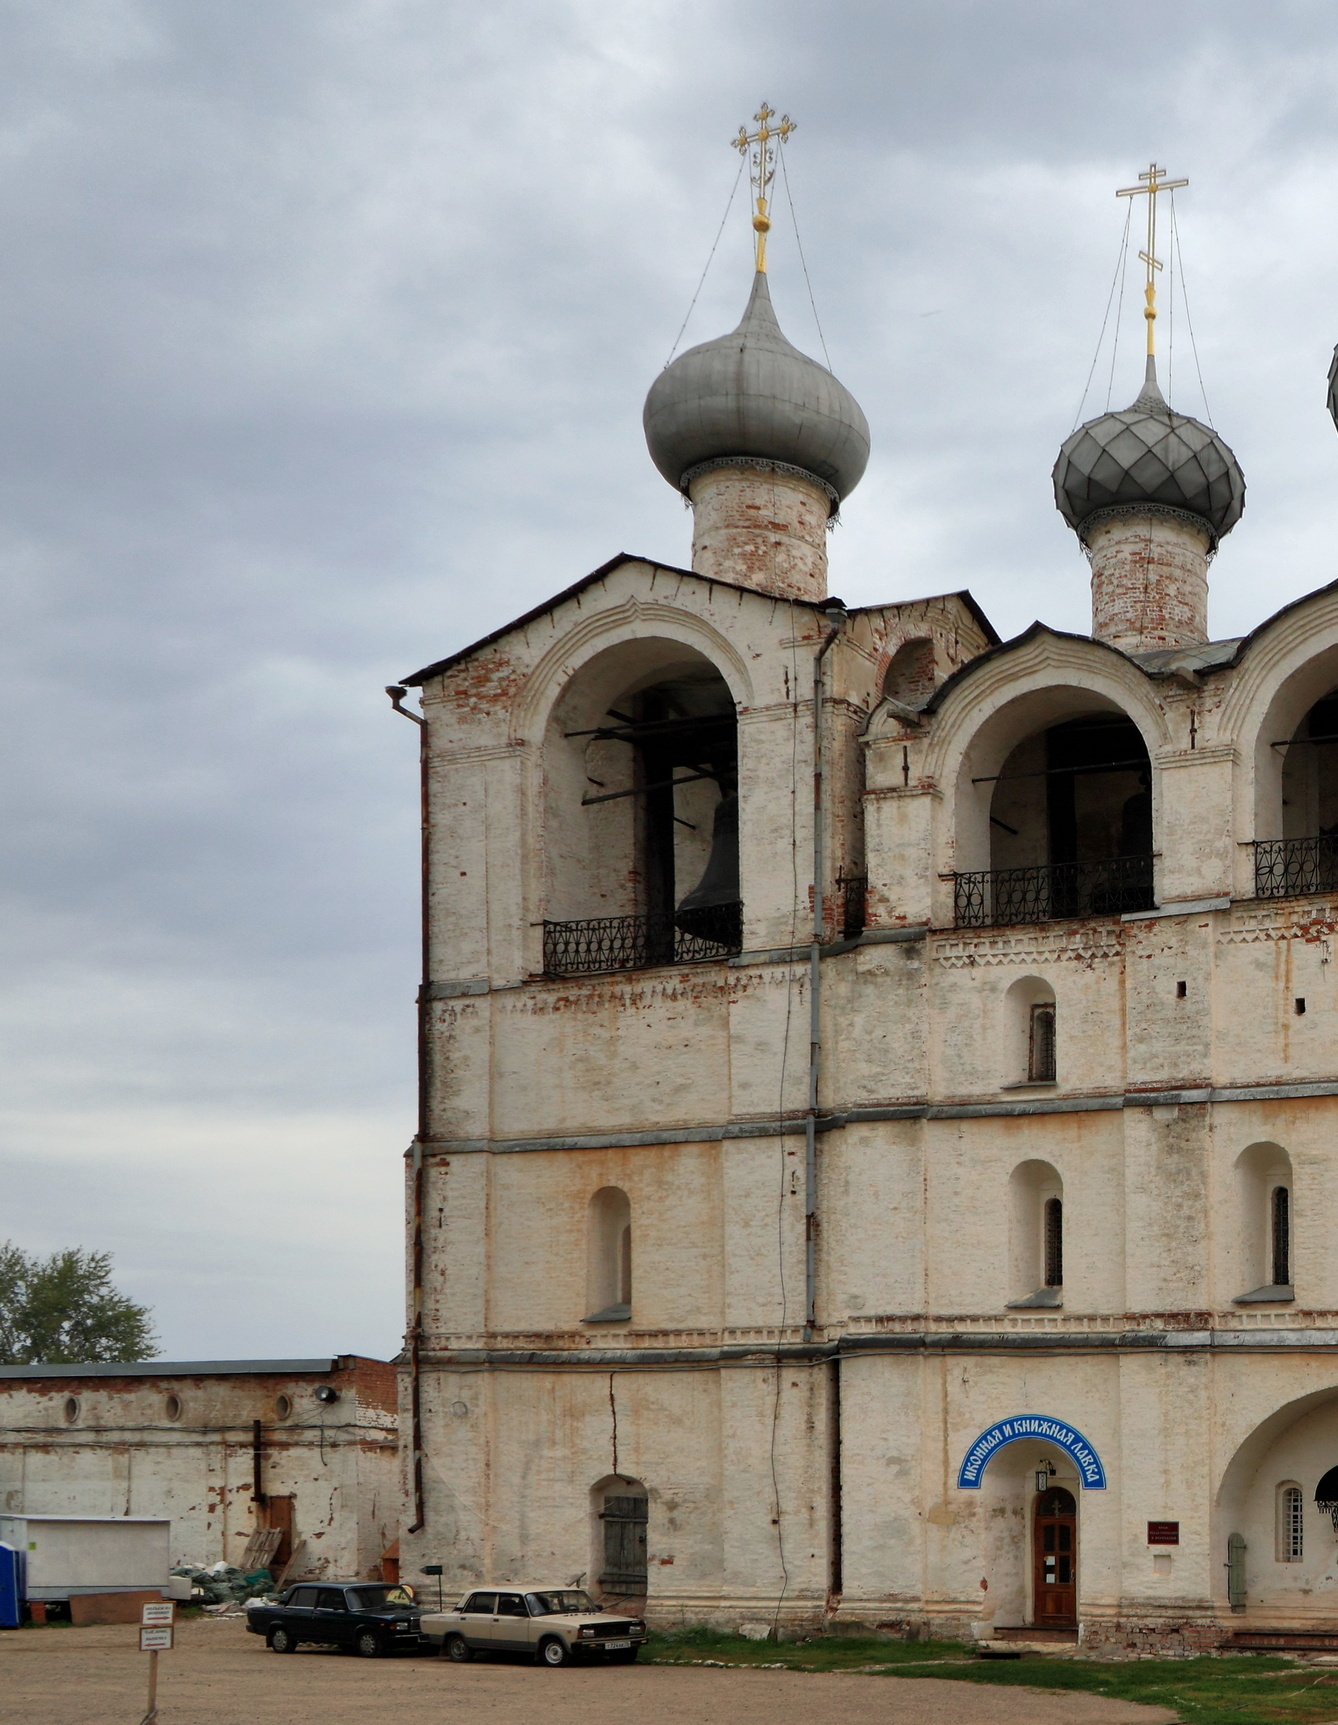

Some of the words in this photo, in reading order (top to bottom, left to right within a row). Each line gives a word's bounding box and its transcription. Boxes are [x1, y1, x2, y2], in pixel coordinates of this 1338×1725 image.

[963, 1429, 1003, 1481] ИКОННАЯ
[1002, 1425, 1013, 1438] И
[1013, 1419, 1076, 1445] КНИЖНАЯ
[1070, 1442, 1100, 1482] ЛАВКА
